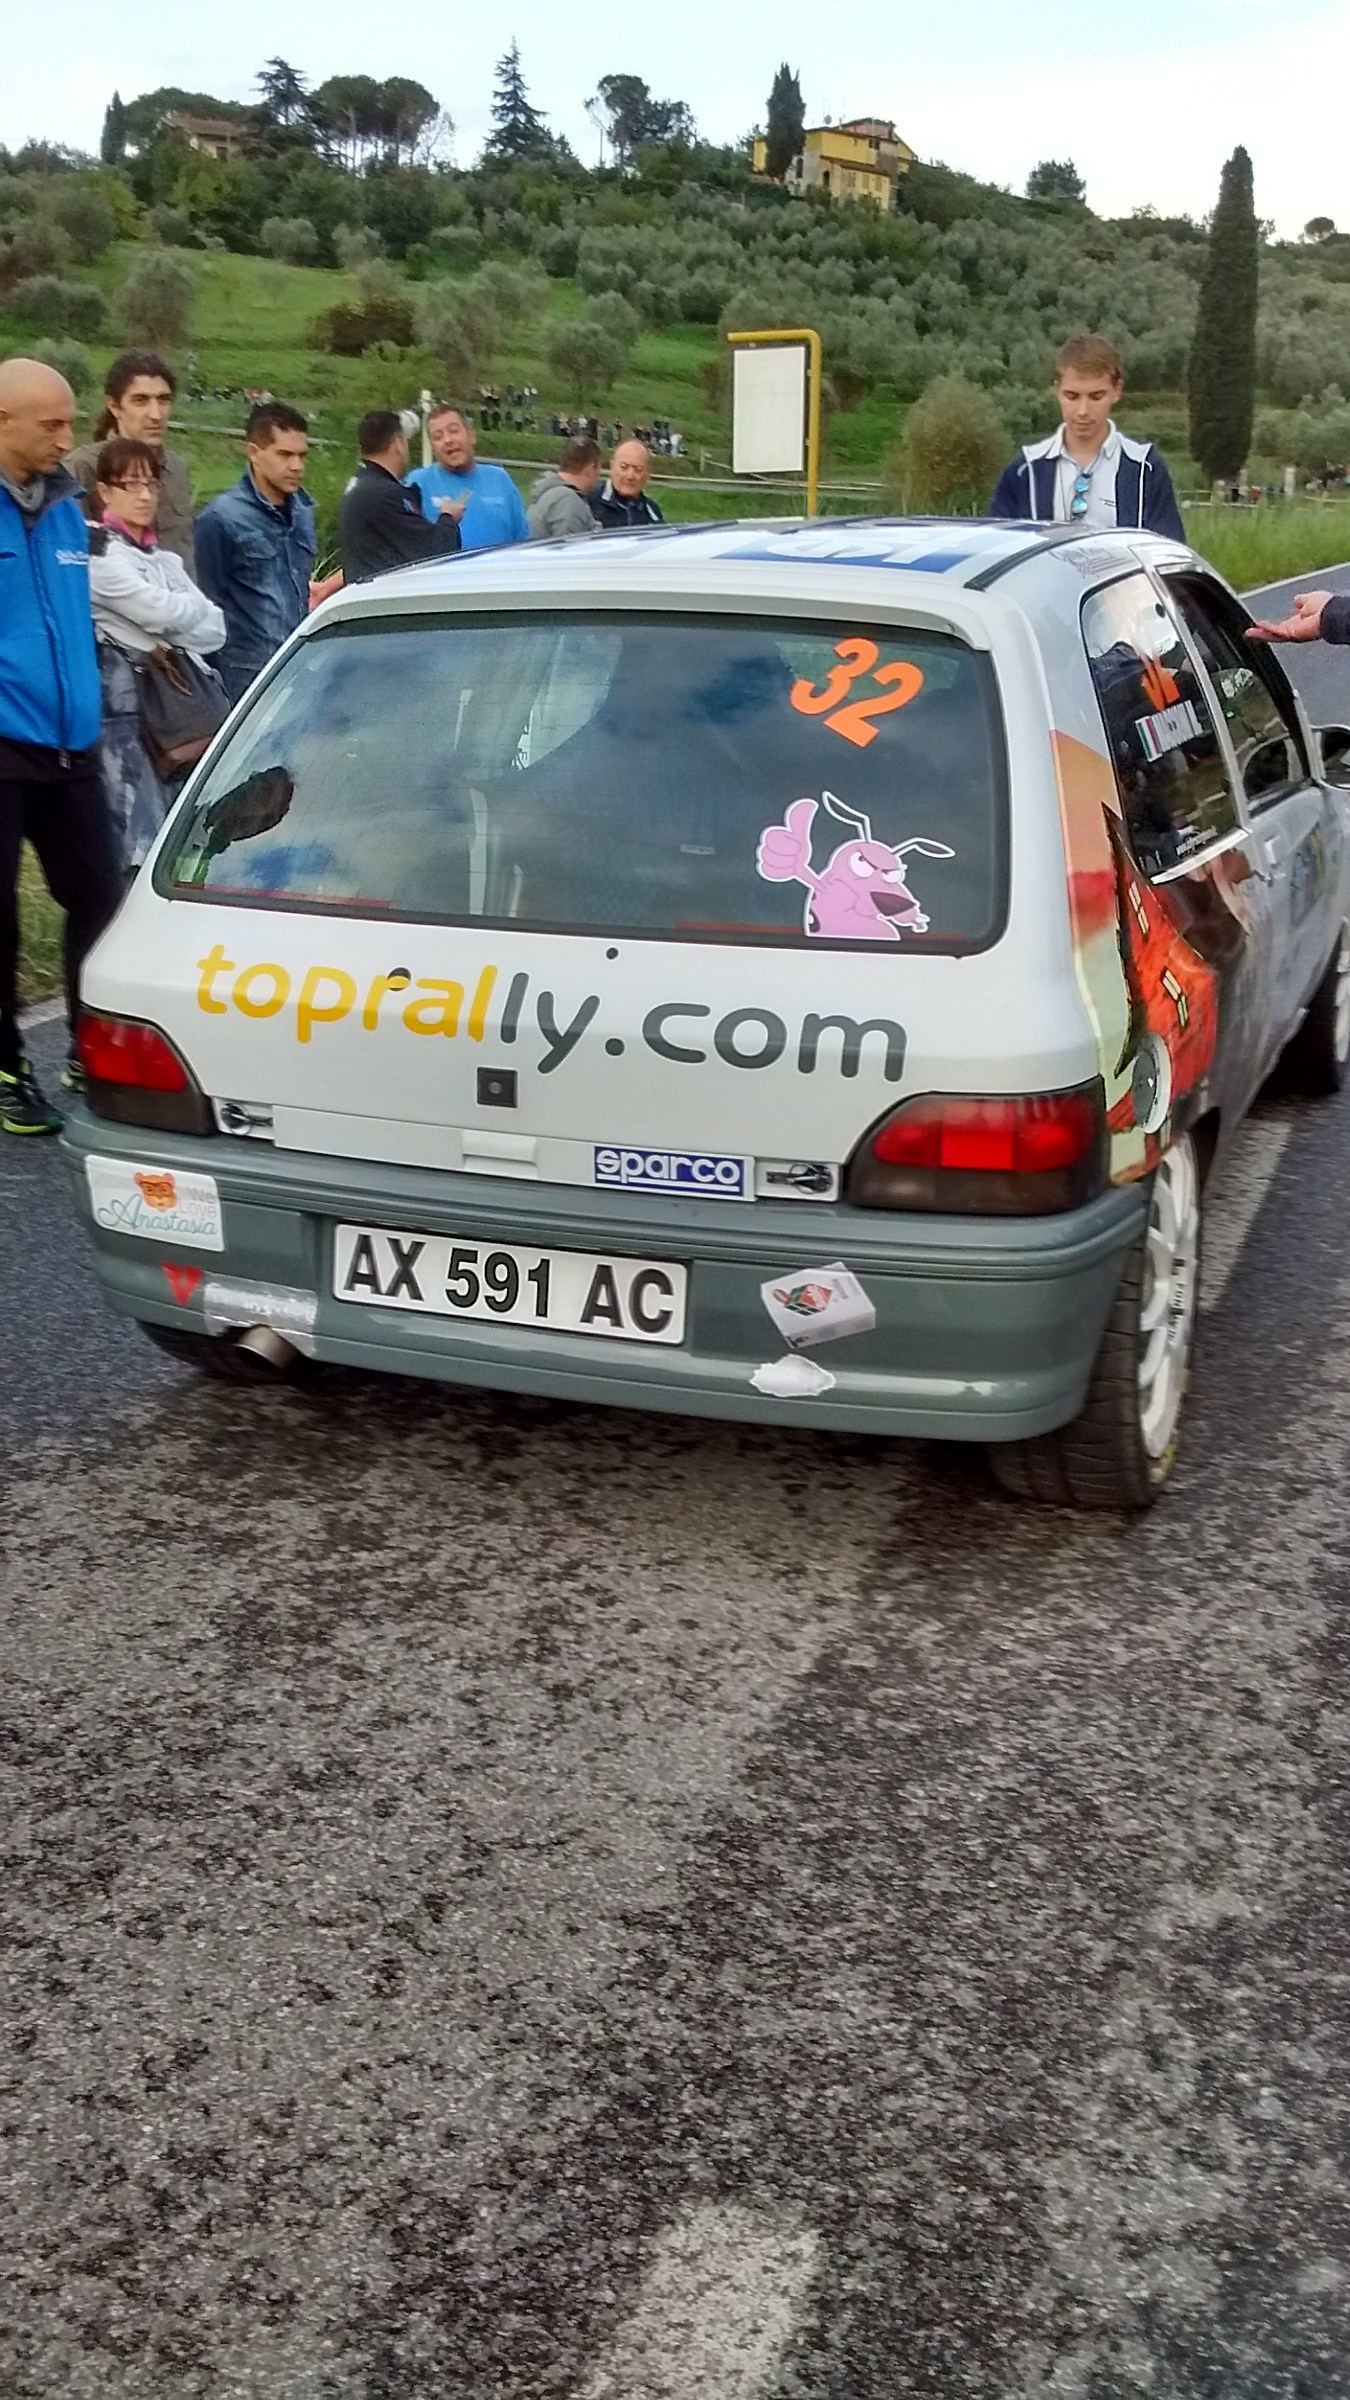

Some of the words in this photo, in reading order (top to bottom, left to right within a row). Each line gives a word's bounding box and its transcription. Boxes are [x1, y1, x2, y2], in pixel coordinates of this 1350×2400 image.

[789, 637, 924, 748] 32
[197, 944, 907, 1082] toprally.com
[187, 1186, 217, 1204] We
[596, 1149, 741, 1185] sparco
[97, 1193, 219, 1236] Anastasia
[343, 1233, 426, 1302] AX
[444, 1247, 551, 1319] 591
[579, 1263, 675, 1334] AC
